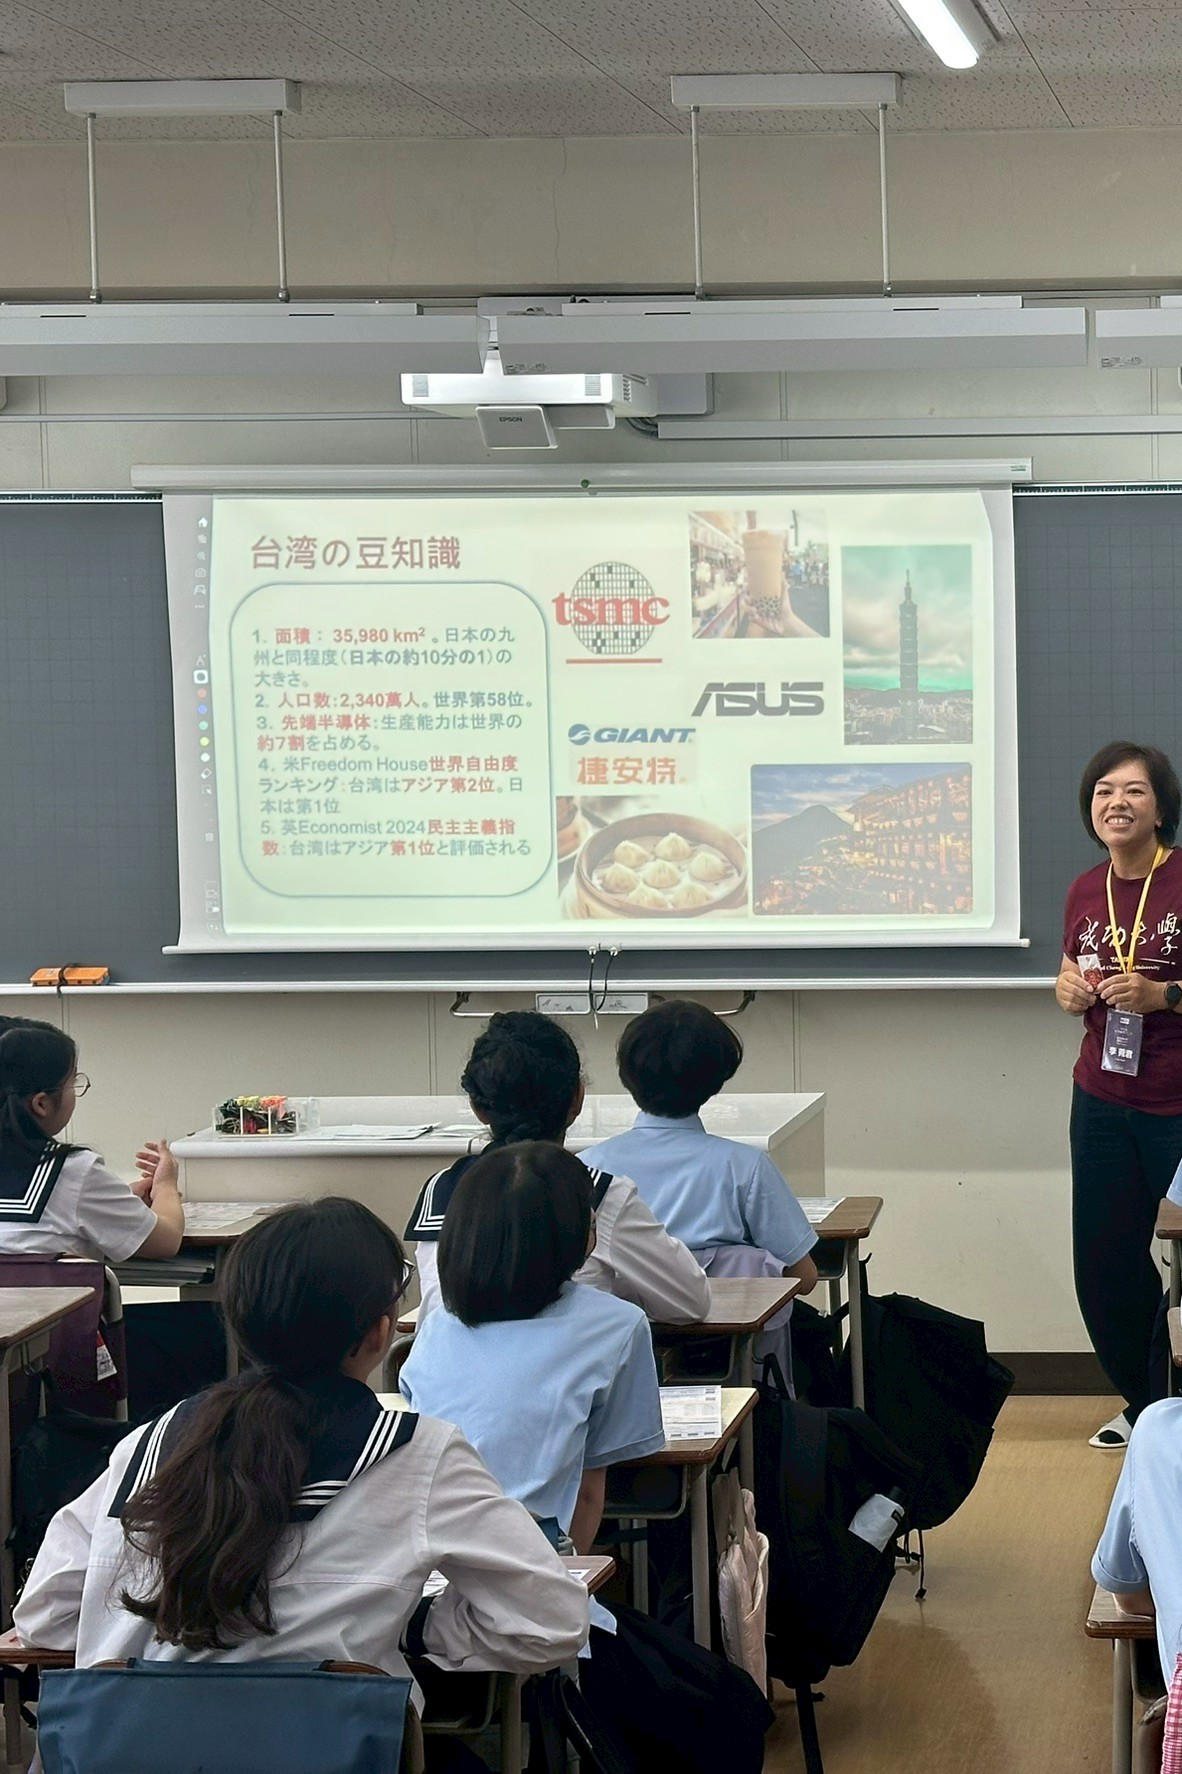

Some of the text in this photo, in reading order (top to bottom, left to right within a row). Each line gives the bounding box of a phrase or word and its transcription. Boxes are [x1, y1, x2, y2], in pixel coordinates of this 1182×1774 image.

[250, 536, 461, 569] 台湾の豆知識
[552, 592, 671, 626] tsmc
[333, 629, 388, 646] 35,980
[254, 671, 309, 688] 大きさ。
[691, 682, 825, 717] ASUS
[256, 734, 381, 752] 約7割を占める。
[593, 728, 696, 743] GIANT
[577, 757, 676, 785] 捷安特
[260, 798, 340, 815] 本は第1位
